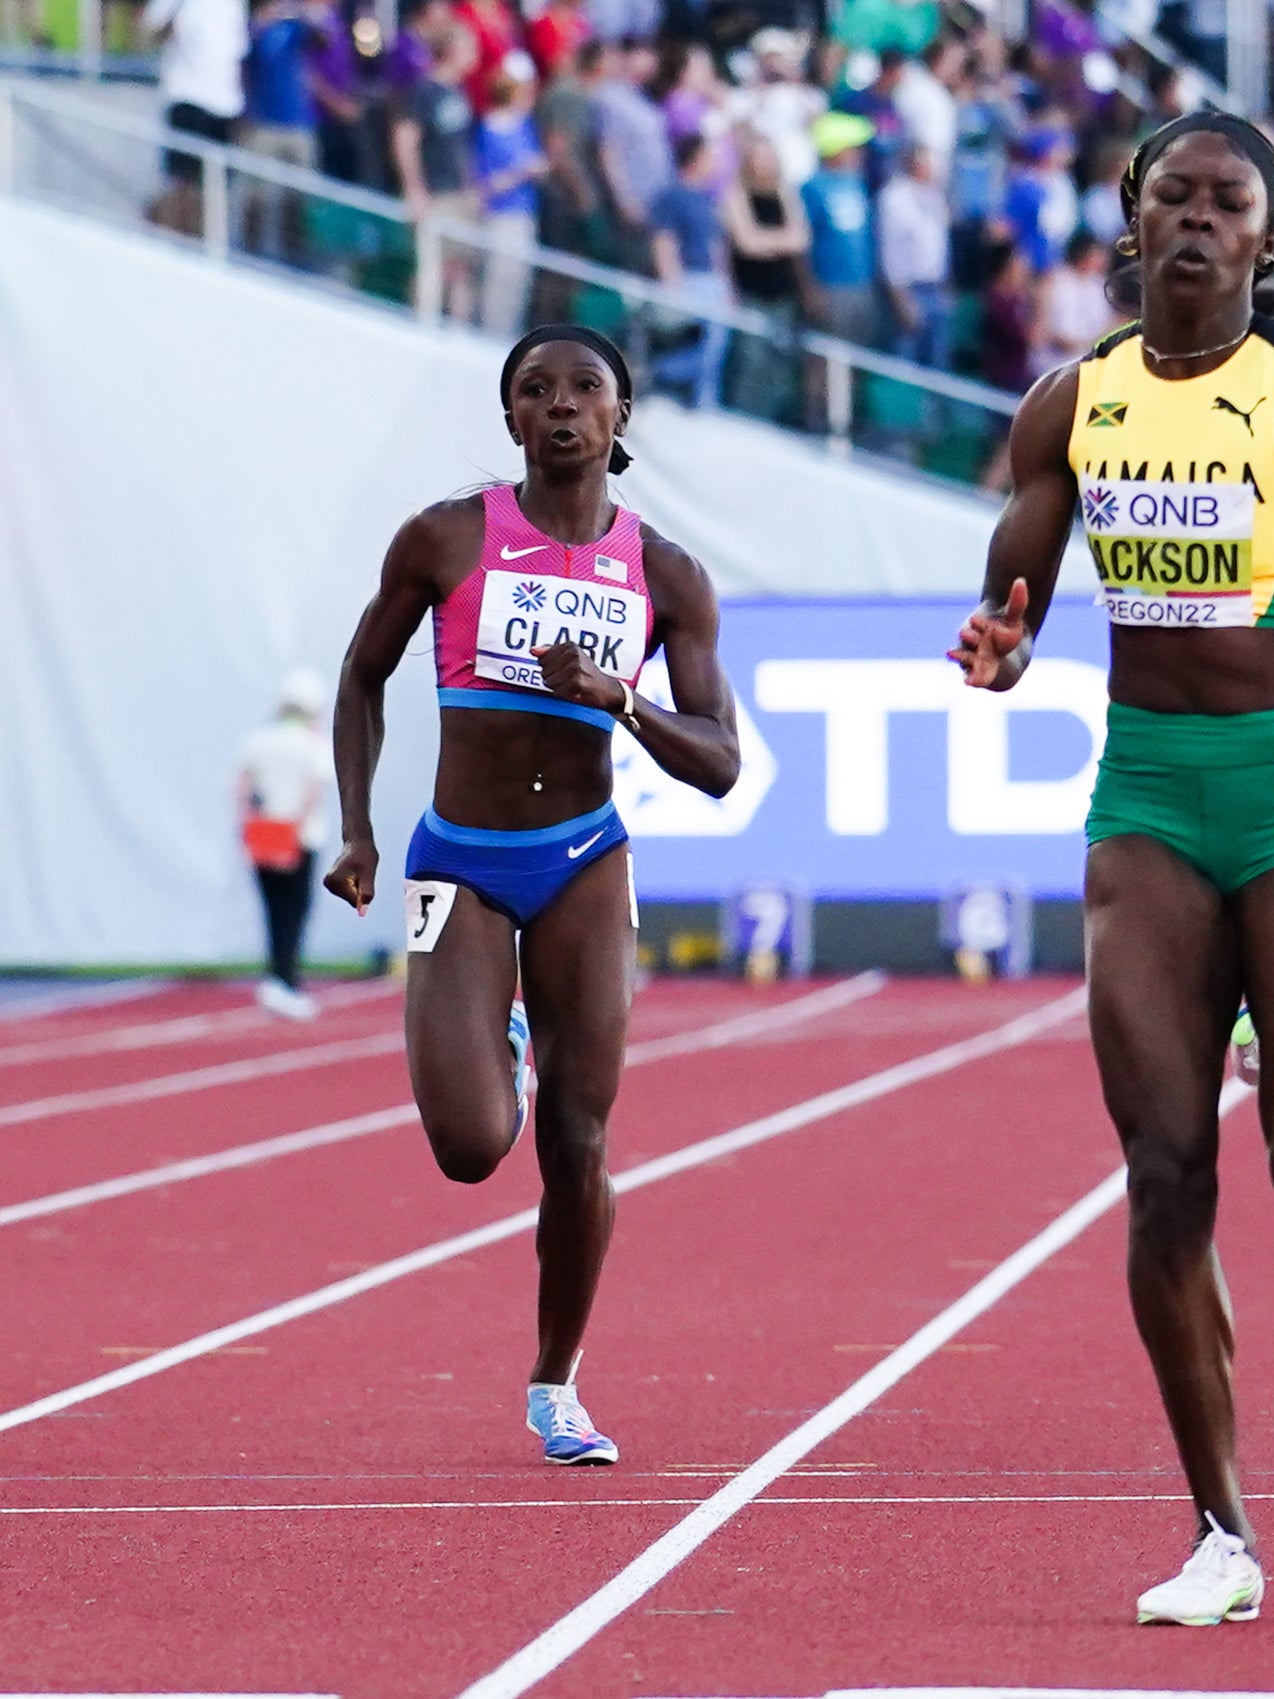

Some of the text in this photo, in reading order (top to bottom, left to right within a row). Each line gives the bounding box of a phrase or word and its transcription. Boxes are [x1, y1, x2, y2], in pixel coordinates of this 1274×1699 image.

[1130, 493, 1219, 527] QNB
[1091, 539, 1238, 584] ACKSON
[555, 589, 627, 625] QNB
[1106, 599, 1218, 623] REGON22
